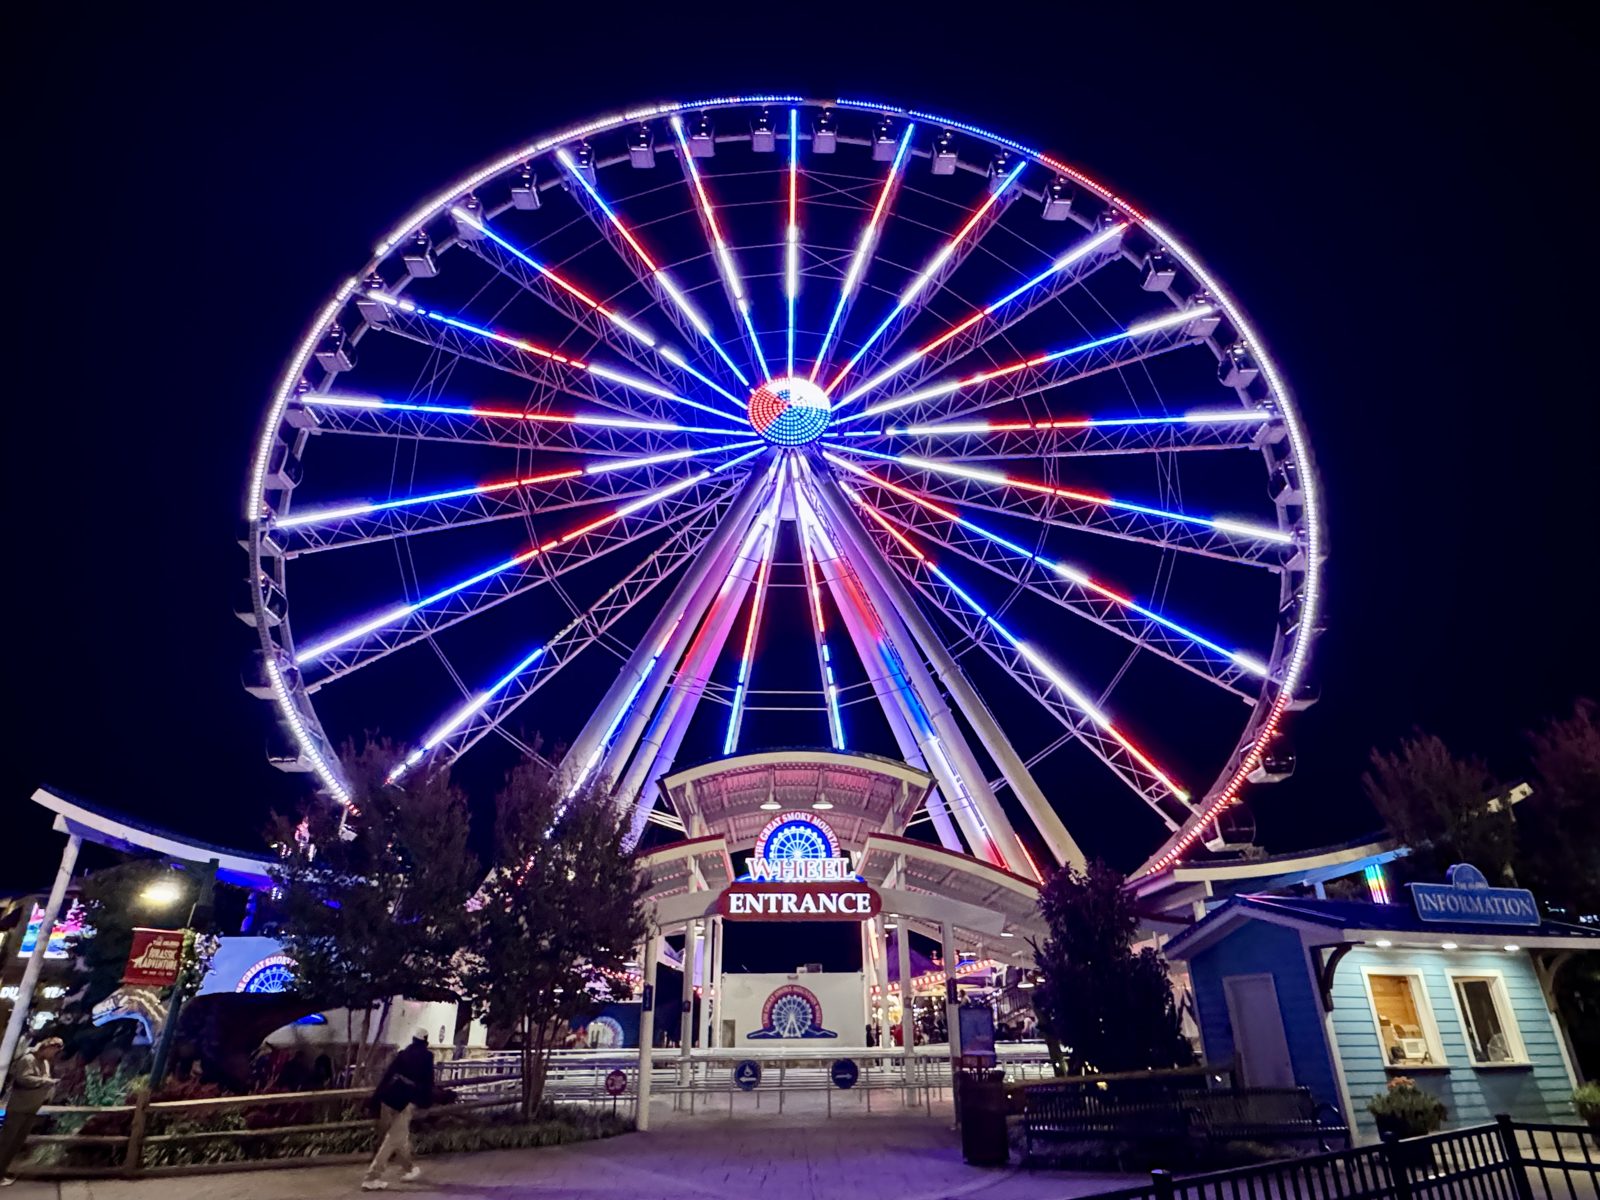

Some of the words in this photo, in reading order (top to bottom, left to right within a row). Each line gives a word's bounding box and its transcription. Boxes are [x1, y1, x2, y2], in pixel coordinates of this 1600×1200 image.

[781, 811, 813, 823] SMOKY
[759, 818, 782, 841] GREAT
[812, 815, 840, 858] MOUNTAIN
[755, 840, 766, 858] THE
[745, 857, 857, 881] WHEEL
[728, 892, 872, 914] ENTRANCE
[1419, 893, 1533, 916] INFORMATION
[242, 960, 266, 983] GREAT
